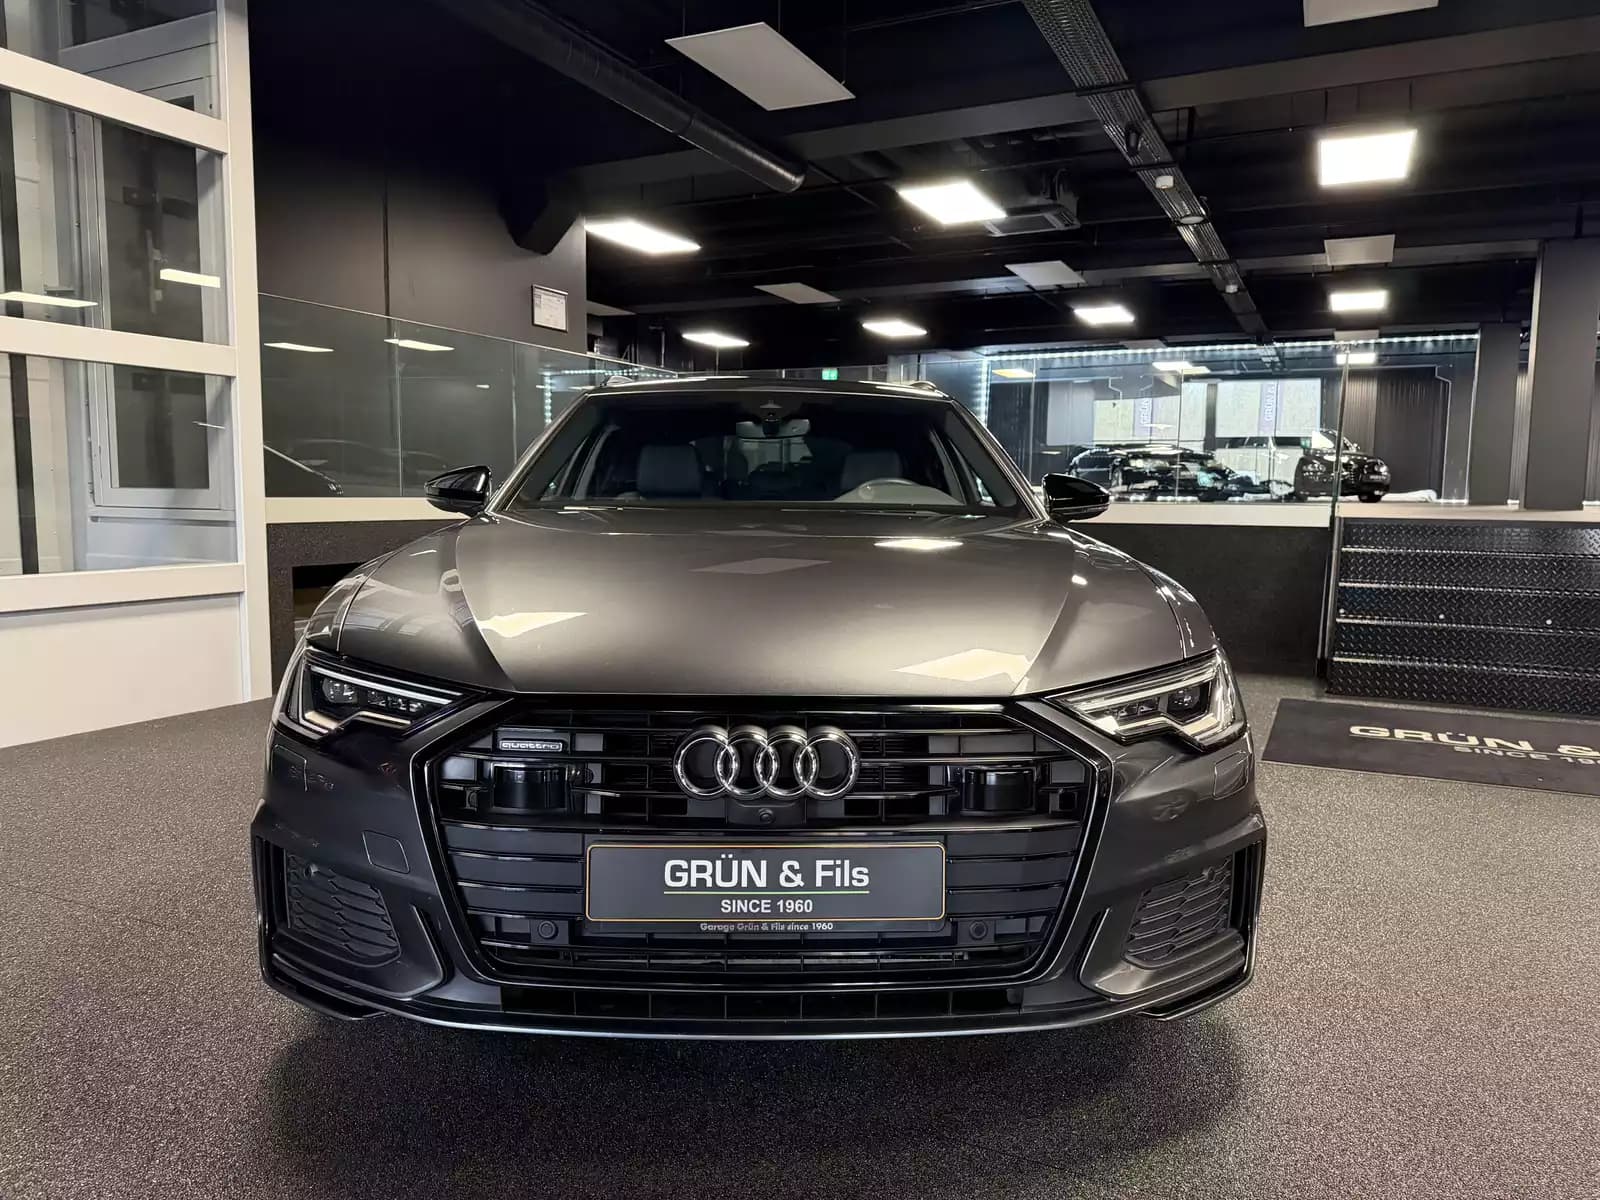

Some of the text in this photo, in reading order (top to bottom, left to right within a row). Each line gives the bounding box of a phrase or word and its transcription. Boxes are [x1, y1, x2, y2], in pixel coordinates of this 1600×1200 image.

[501, 741, 560, 750] quattro
[1349, 725, 1600, 757] GRÜN &
[1454, 746, 1600, 765] SINCE 19
[664, 853, 870, 888] GRÜN & Fils
[720, 899, 813, 913] SINCE 1960
[700, 922, 834, 933] Garage Grün & Fils since 1960
